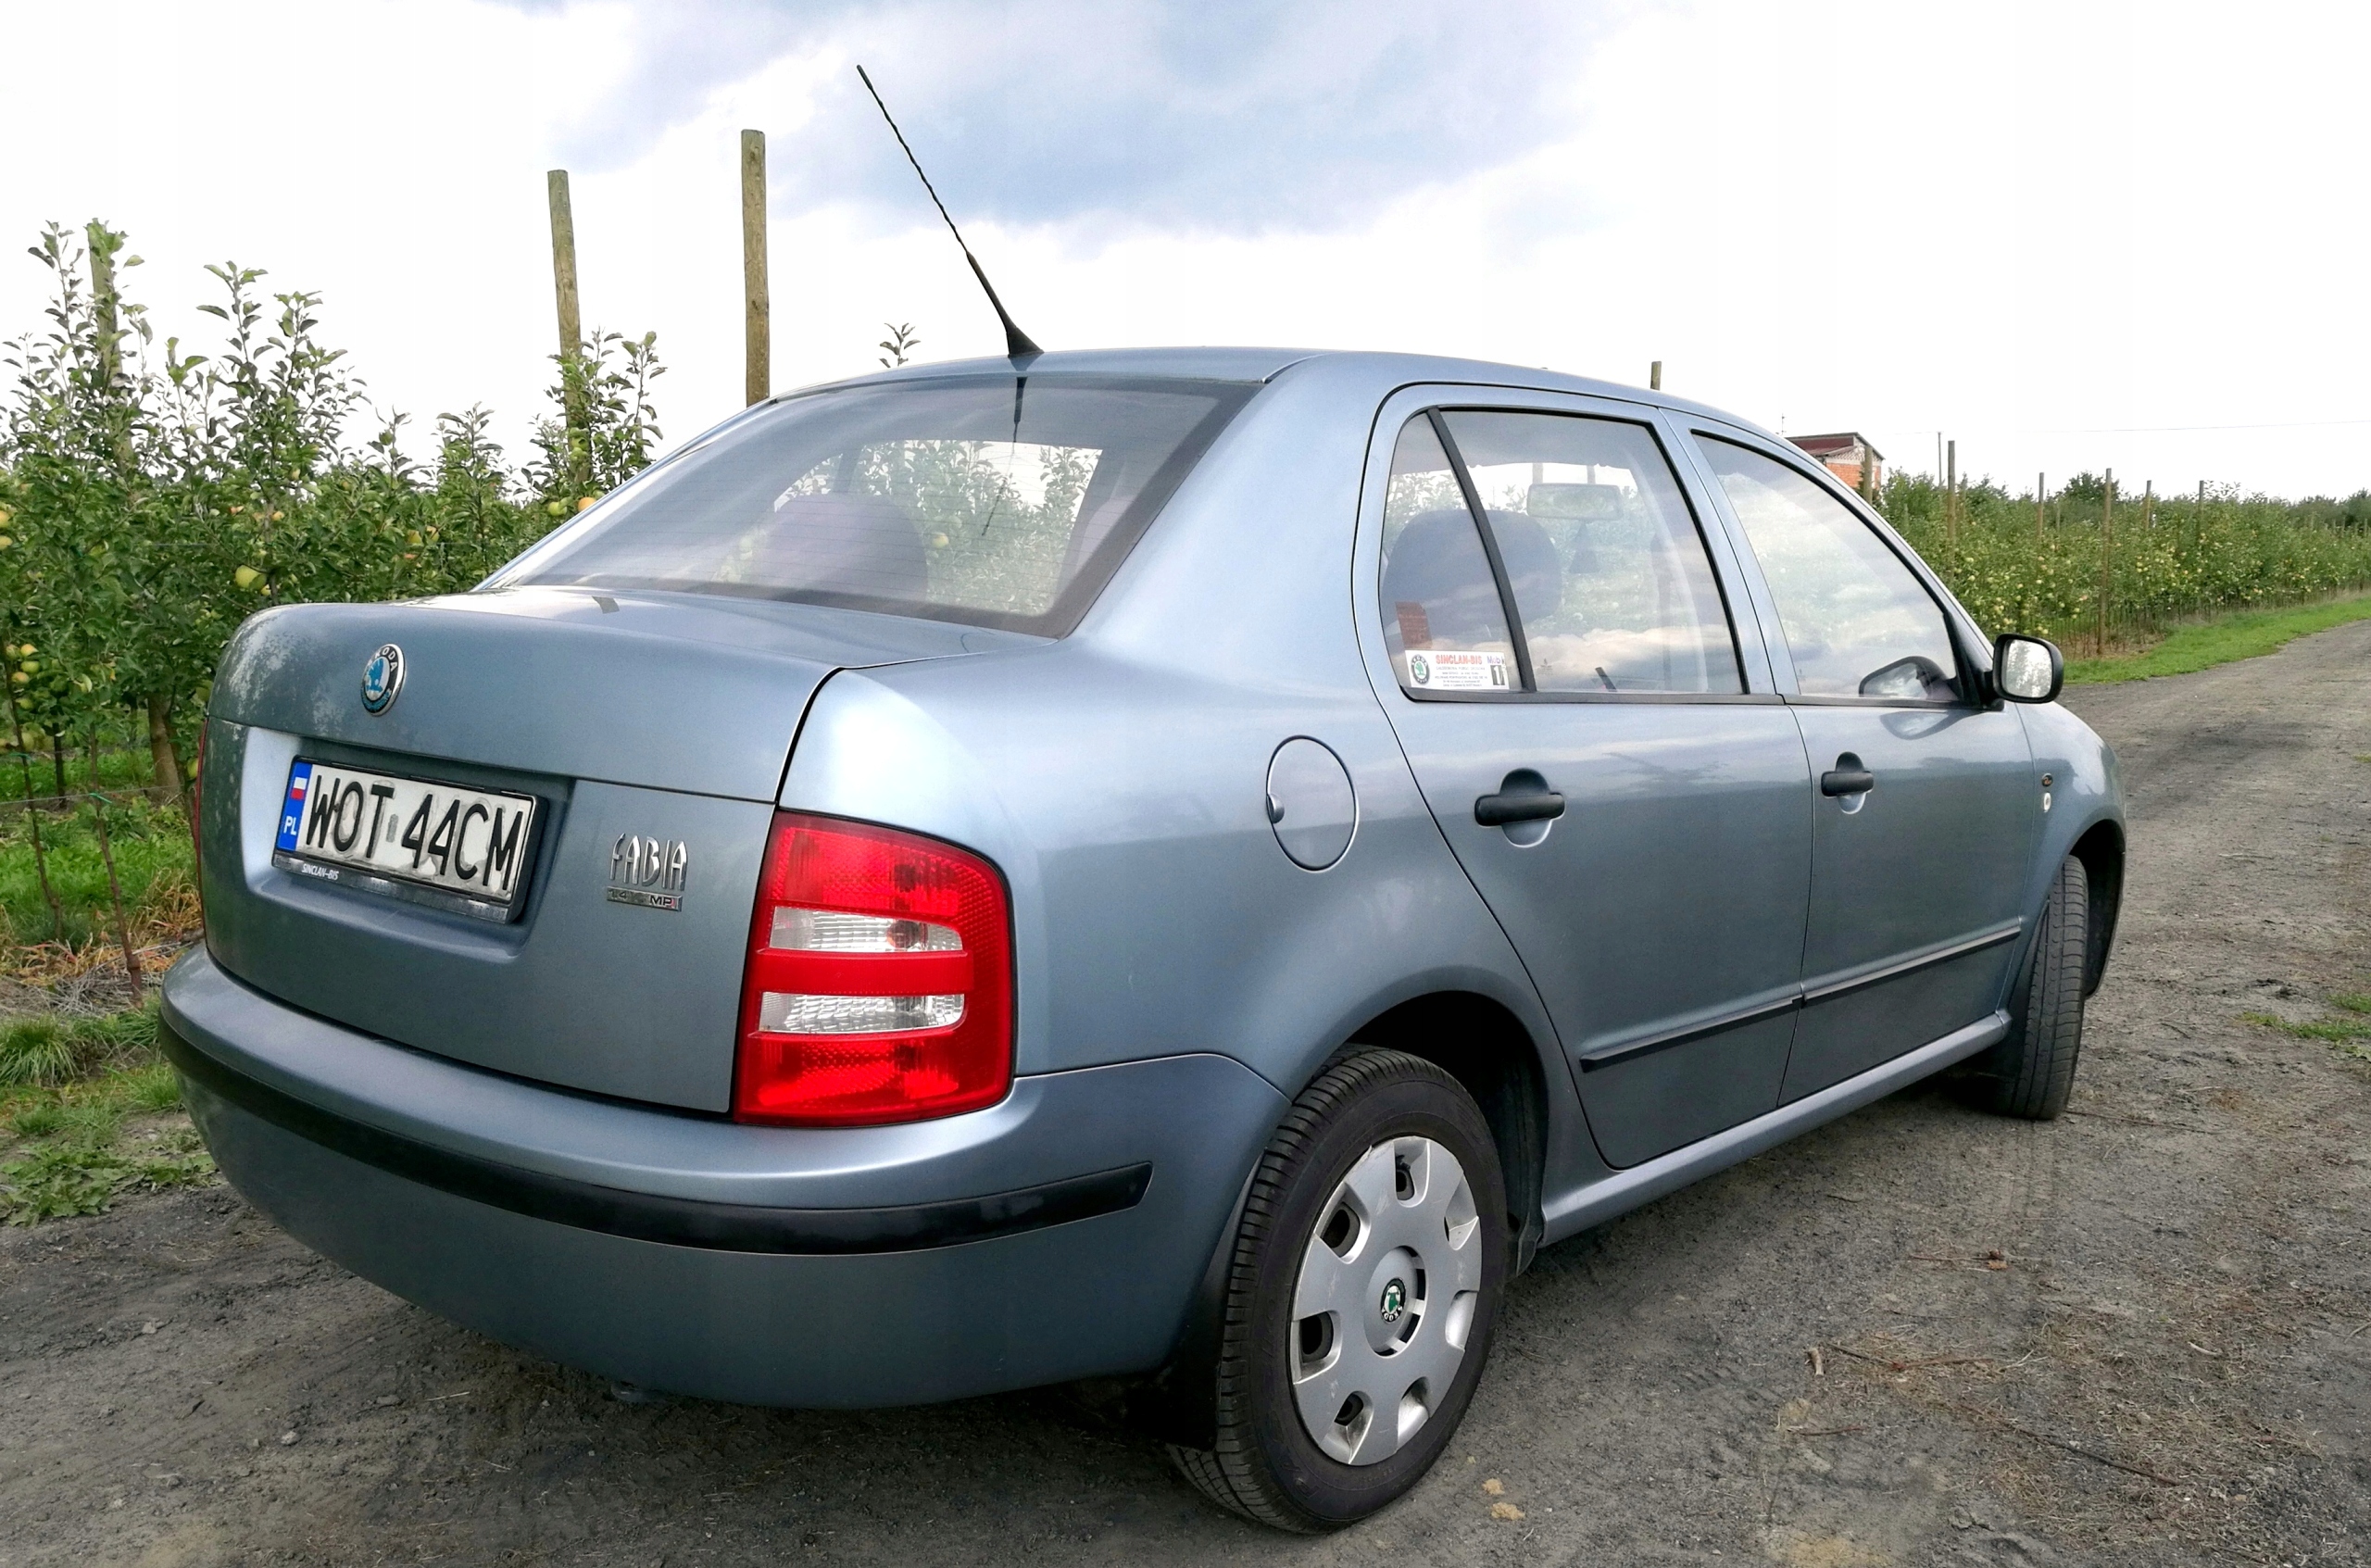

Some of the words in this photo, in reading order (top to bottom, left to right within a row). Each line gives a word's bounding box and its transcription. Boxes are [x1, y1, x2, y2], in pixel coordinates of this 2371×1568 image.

[1436, 654, 1483, 664] SINCLAN-BIS
[283, 816, 296, 835] PL
[306, 774, 395, 859] WOT
[401, 794, 523, 891] 44CM
[609, 833, 688, 891] FABIA
[301, 863, 339, 881] SINCLAN-BIS
